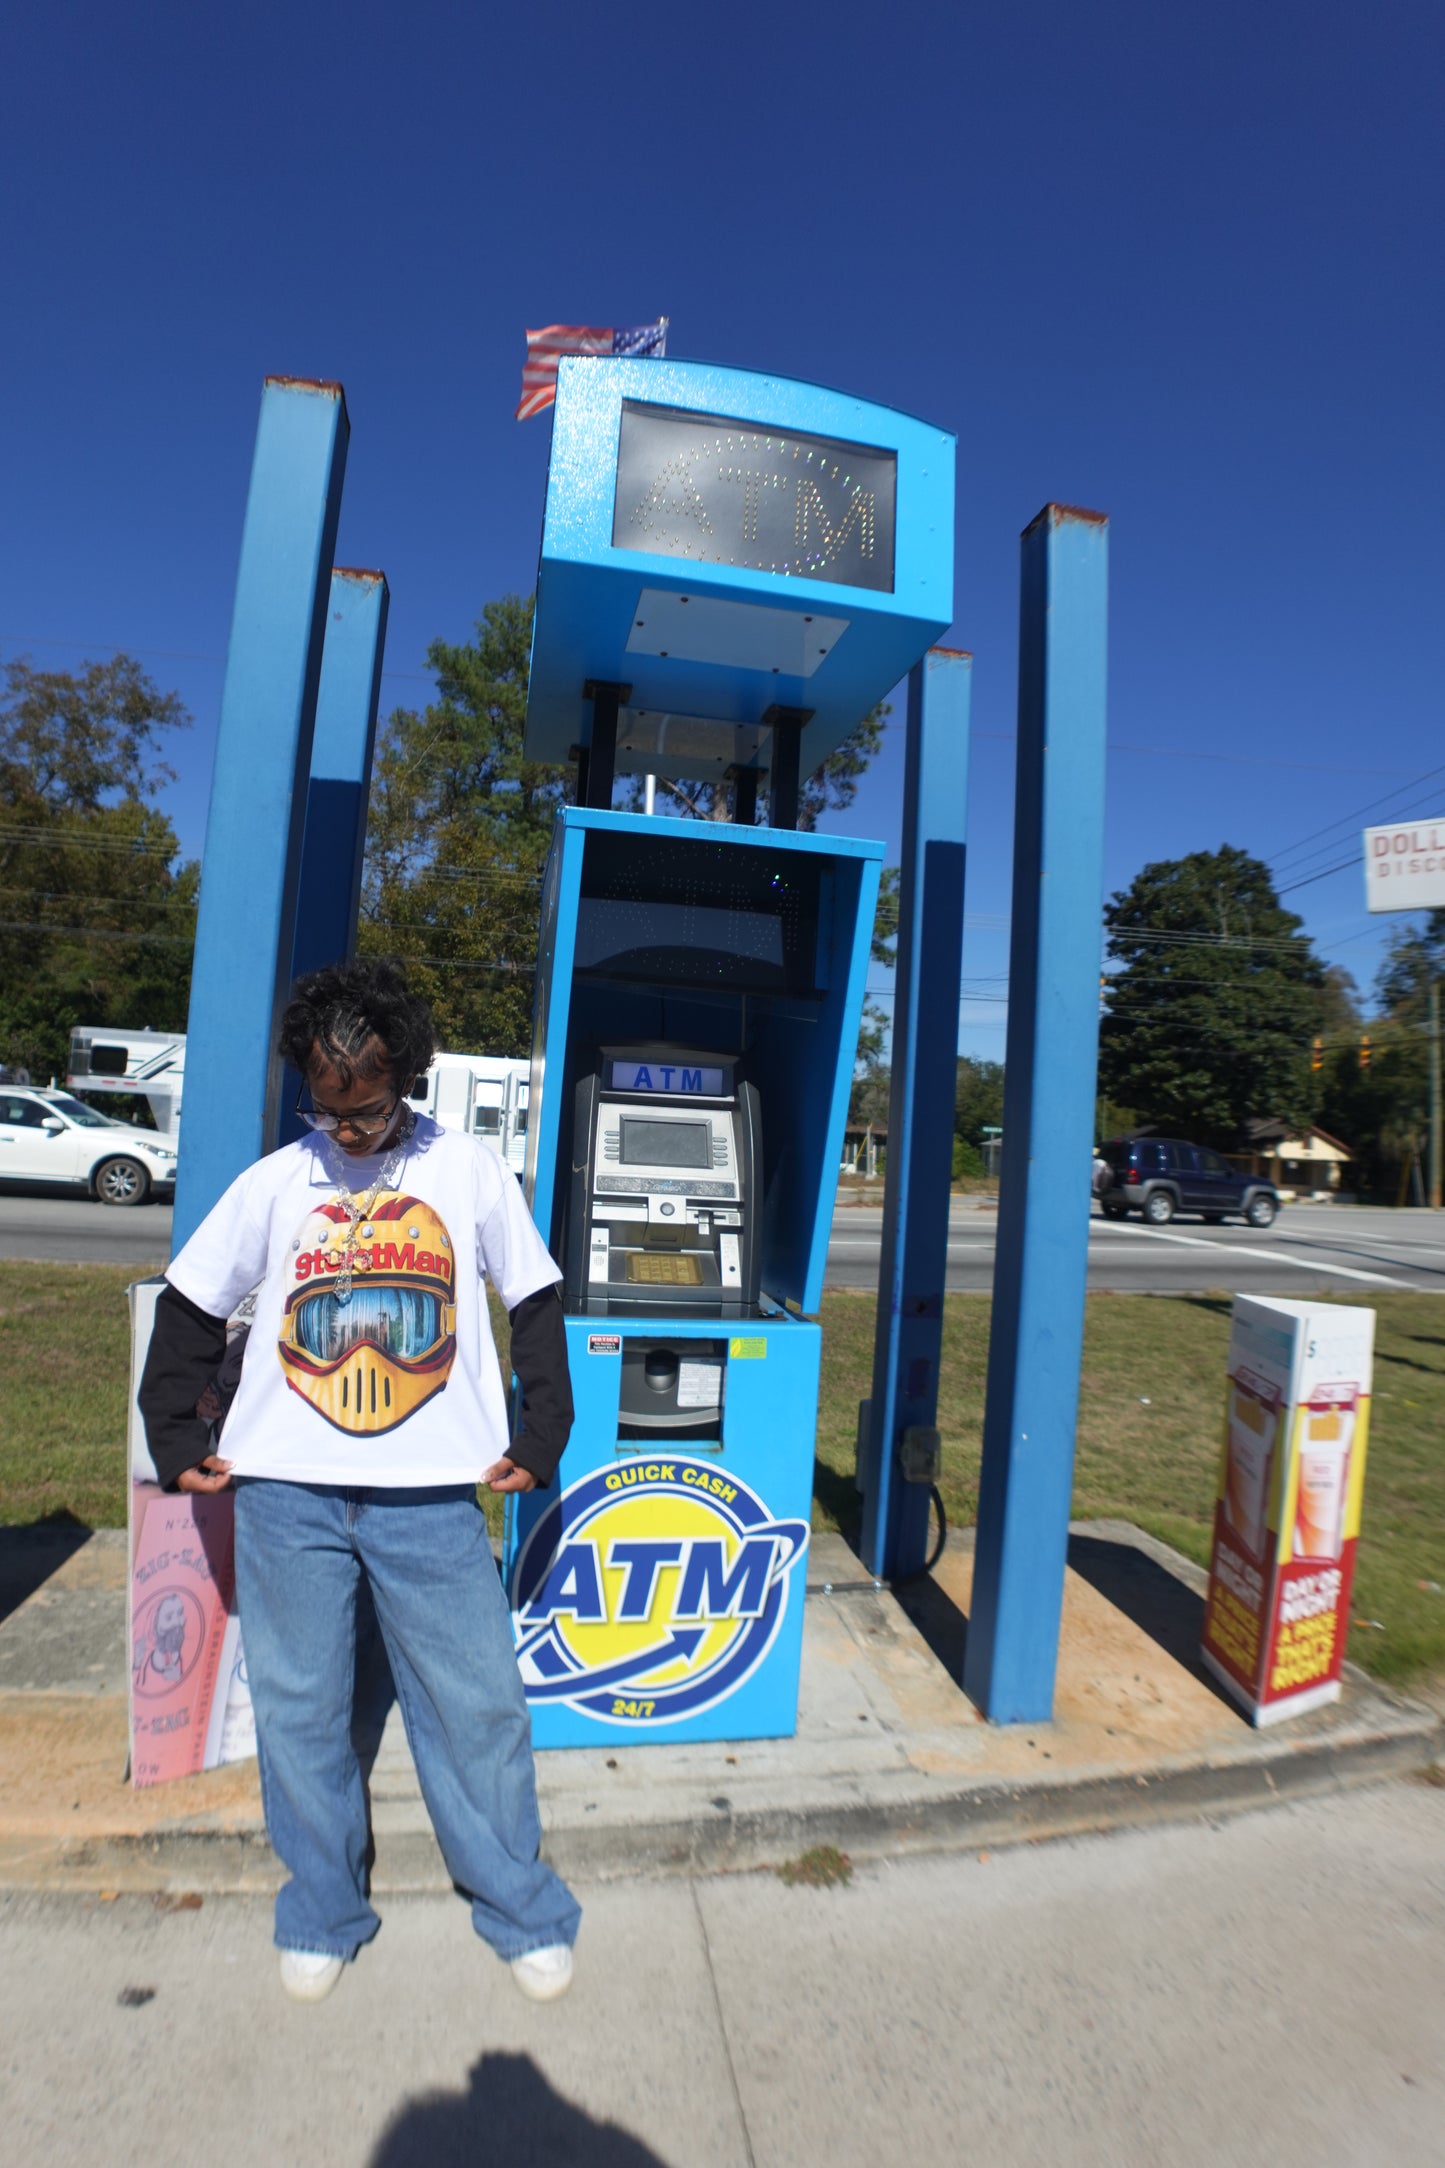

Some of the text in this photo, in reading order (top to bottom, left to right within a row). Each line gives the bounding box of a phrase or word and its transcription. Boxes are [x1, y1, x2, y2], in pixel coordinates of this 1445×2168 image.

[629, 460, 876, 560] ATM
[633, 1065, 703, 1092] ATM
[605, 1464, 738, 1504] QUICK CASH
[136, 1548, 218, 1585] ZIG-ZAG
[522, 1536, 780, 1622] ATM
[610, 1699, 656, 1718] 24/7
